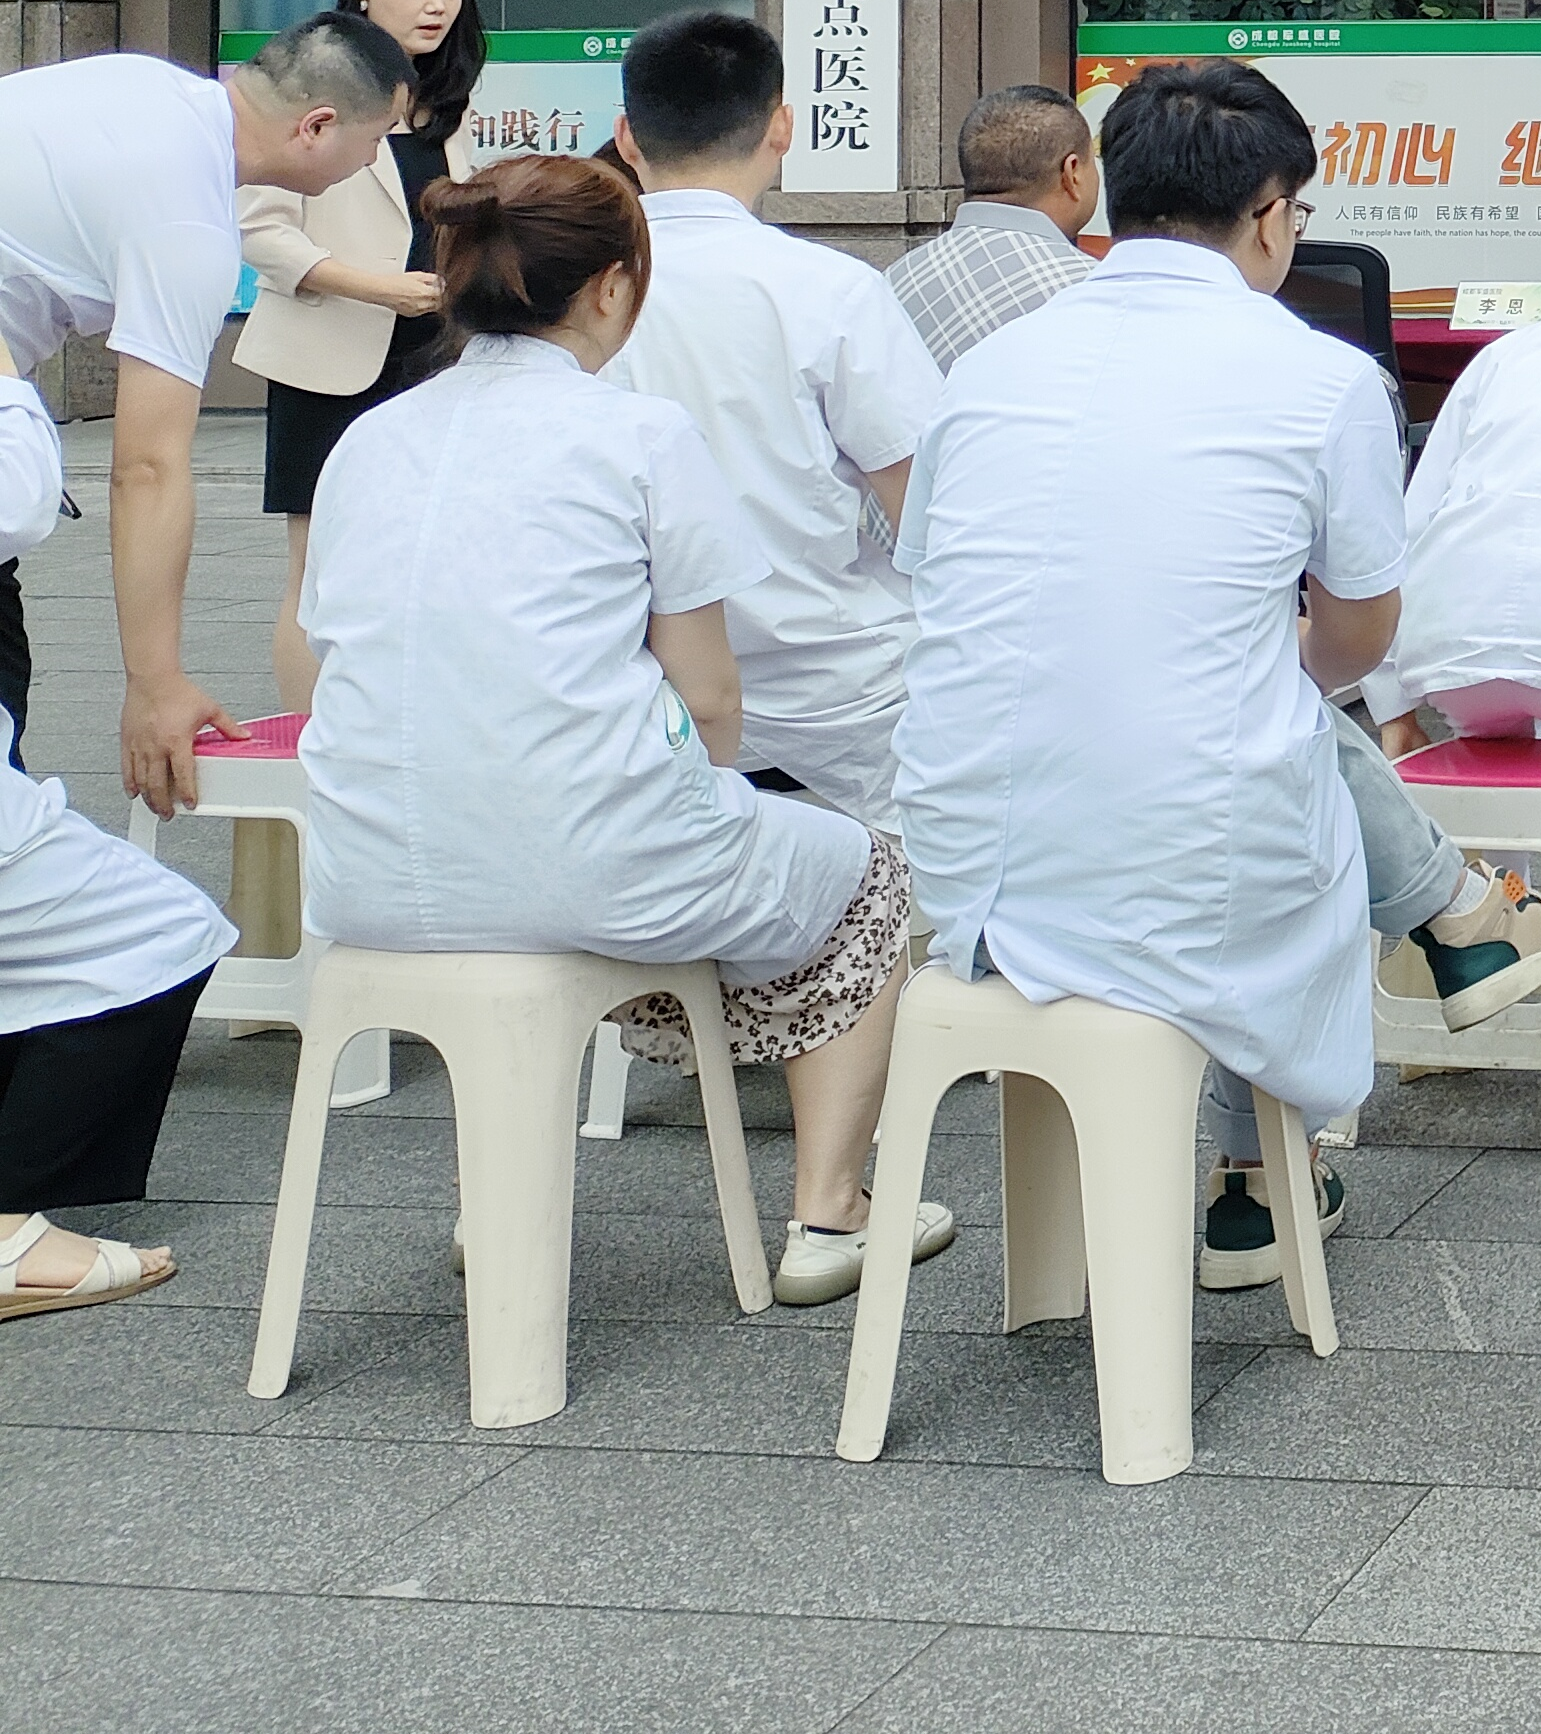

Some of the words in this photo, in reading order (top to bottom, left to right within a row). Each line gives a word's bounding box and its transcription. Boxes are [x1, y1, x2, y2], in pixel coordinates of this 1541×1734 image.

[1308, 121, 1457, 187] 初心
[1335, 205, 1418, 221] 人民有信仰
[1436, 205, 1519, 221] 民族有希望
[1366, 229, 1388, 238] people
[1490, 229, 1511, 238] hope,
[1479, 298, 1523, 315] 李恩
